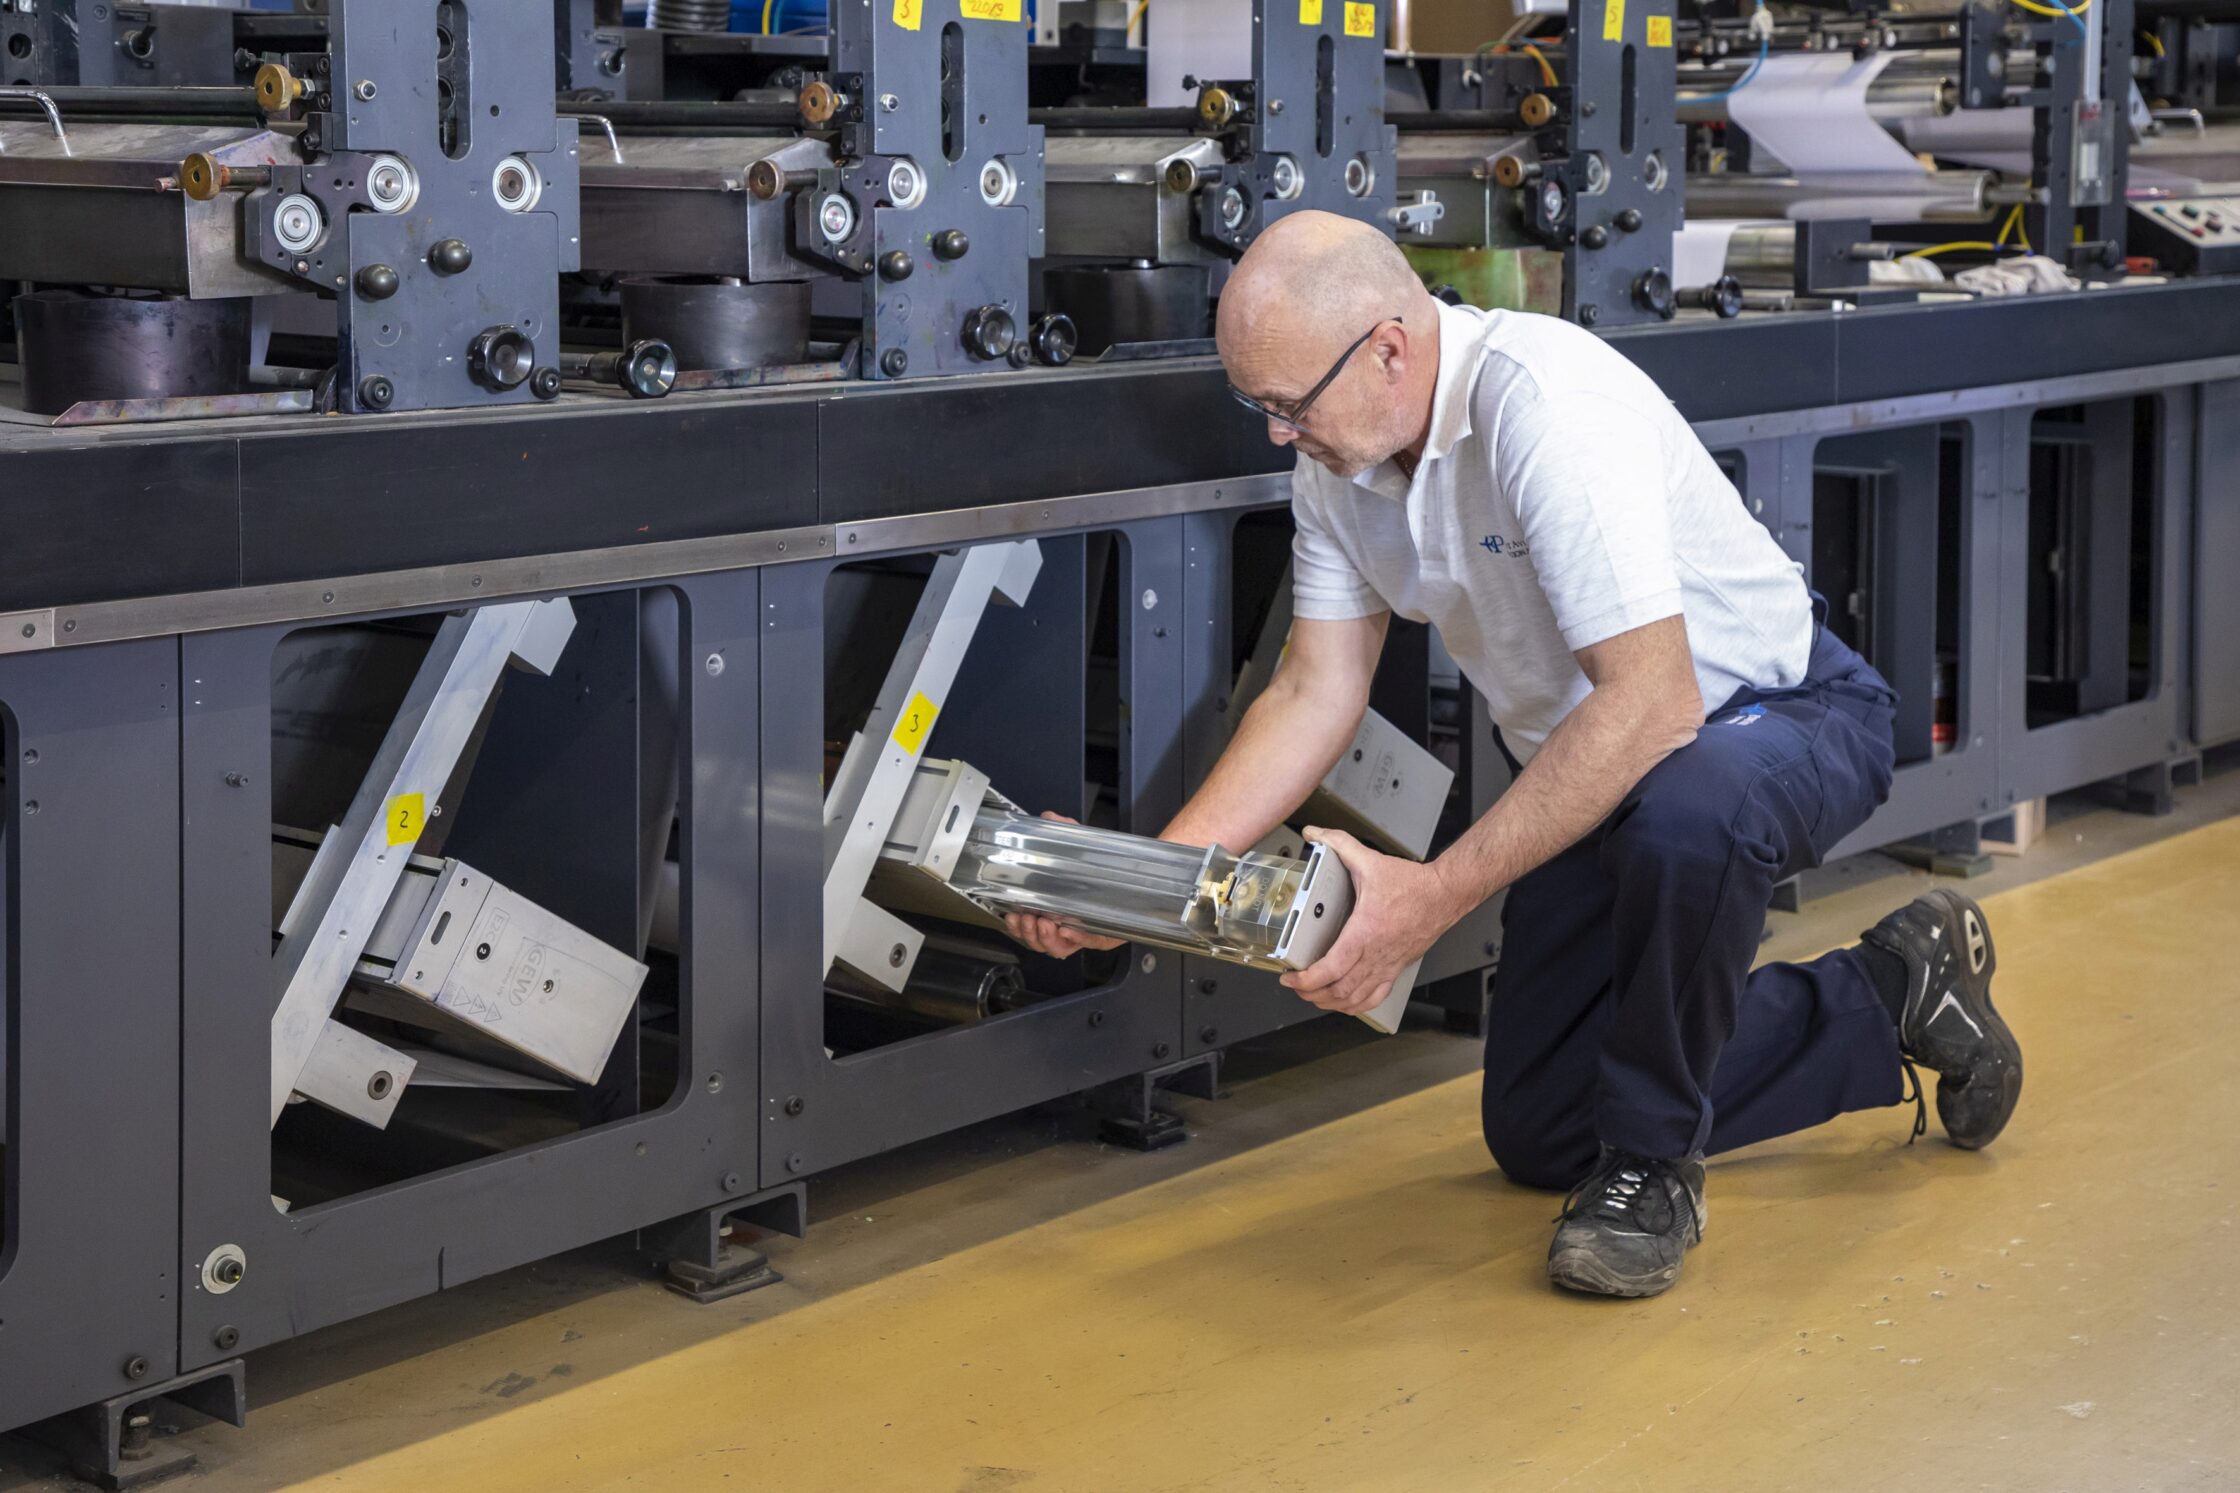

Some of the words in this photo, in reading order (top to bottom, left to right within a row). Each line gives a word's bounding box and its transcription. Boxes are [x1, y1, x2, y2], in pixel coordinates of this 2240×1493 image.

[909, 714, 919, 733] 3
[400, 810, 409, 828] 2
[511, 947, 543, 1002] GEW
